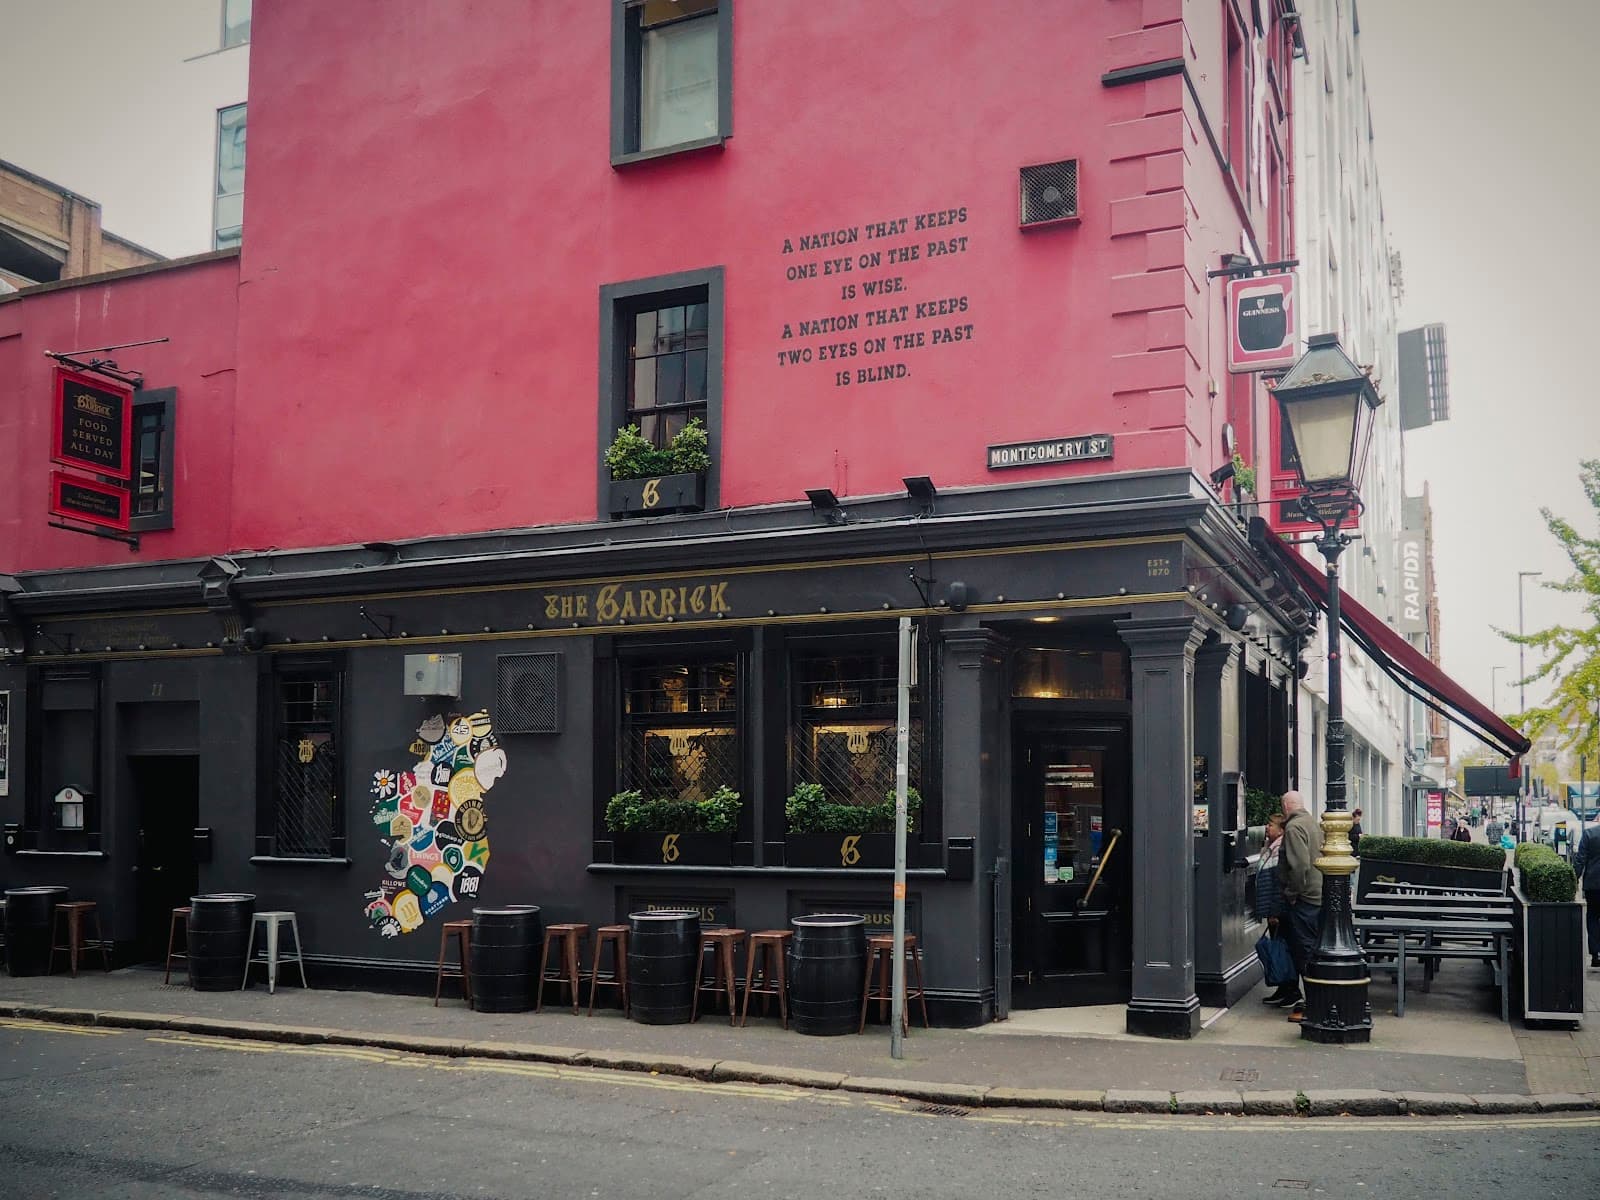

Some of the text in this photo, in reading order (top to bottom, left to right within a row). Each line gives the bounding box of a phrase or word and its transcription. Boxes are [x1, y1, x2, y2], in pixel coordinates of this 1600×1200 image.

[782, 207, 968, 254] A NATION THAT KEEPS
[786, 237, 968, 281] ONE EYE ON THE PAST
[841, 277, 908, 300] IS WISE.
[781, 296, 969, 339] A NATION THAT KEEPS
[1242, 307, 1280, 317] GUINNESS
[777, 324, 974, 366] TWO EYES ON THE PAST
[835, 363, 911, 387] IS BLIND.
[79, 418, 108, 432] FOOD
[72, 429, 113, 446] SERVED
[1090, 440, 1106, 454] ST
[71, 442, 113, 460] ALL DAY
[543, 581, 732, 622] THE GARRICK
[864, 913, 894, 925] BUS
